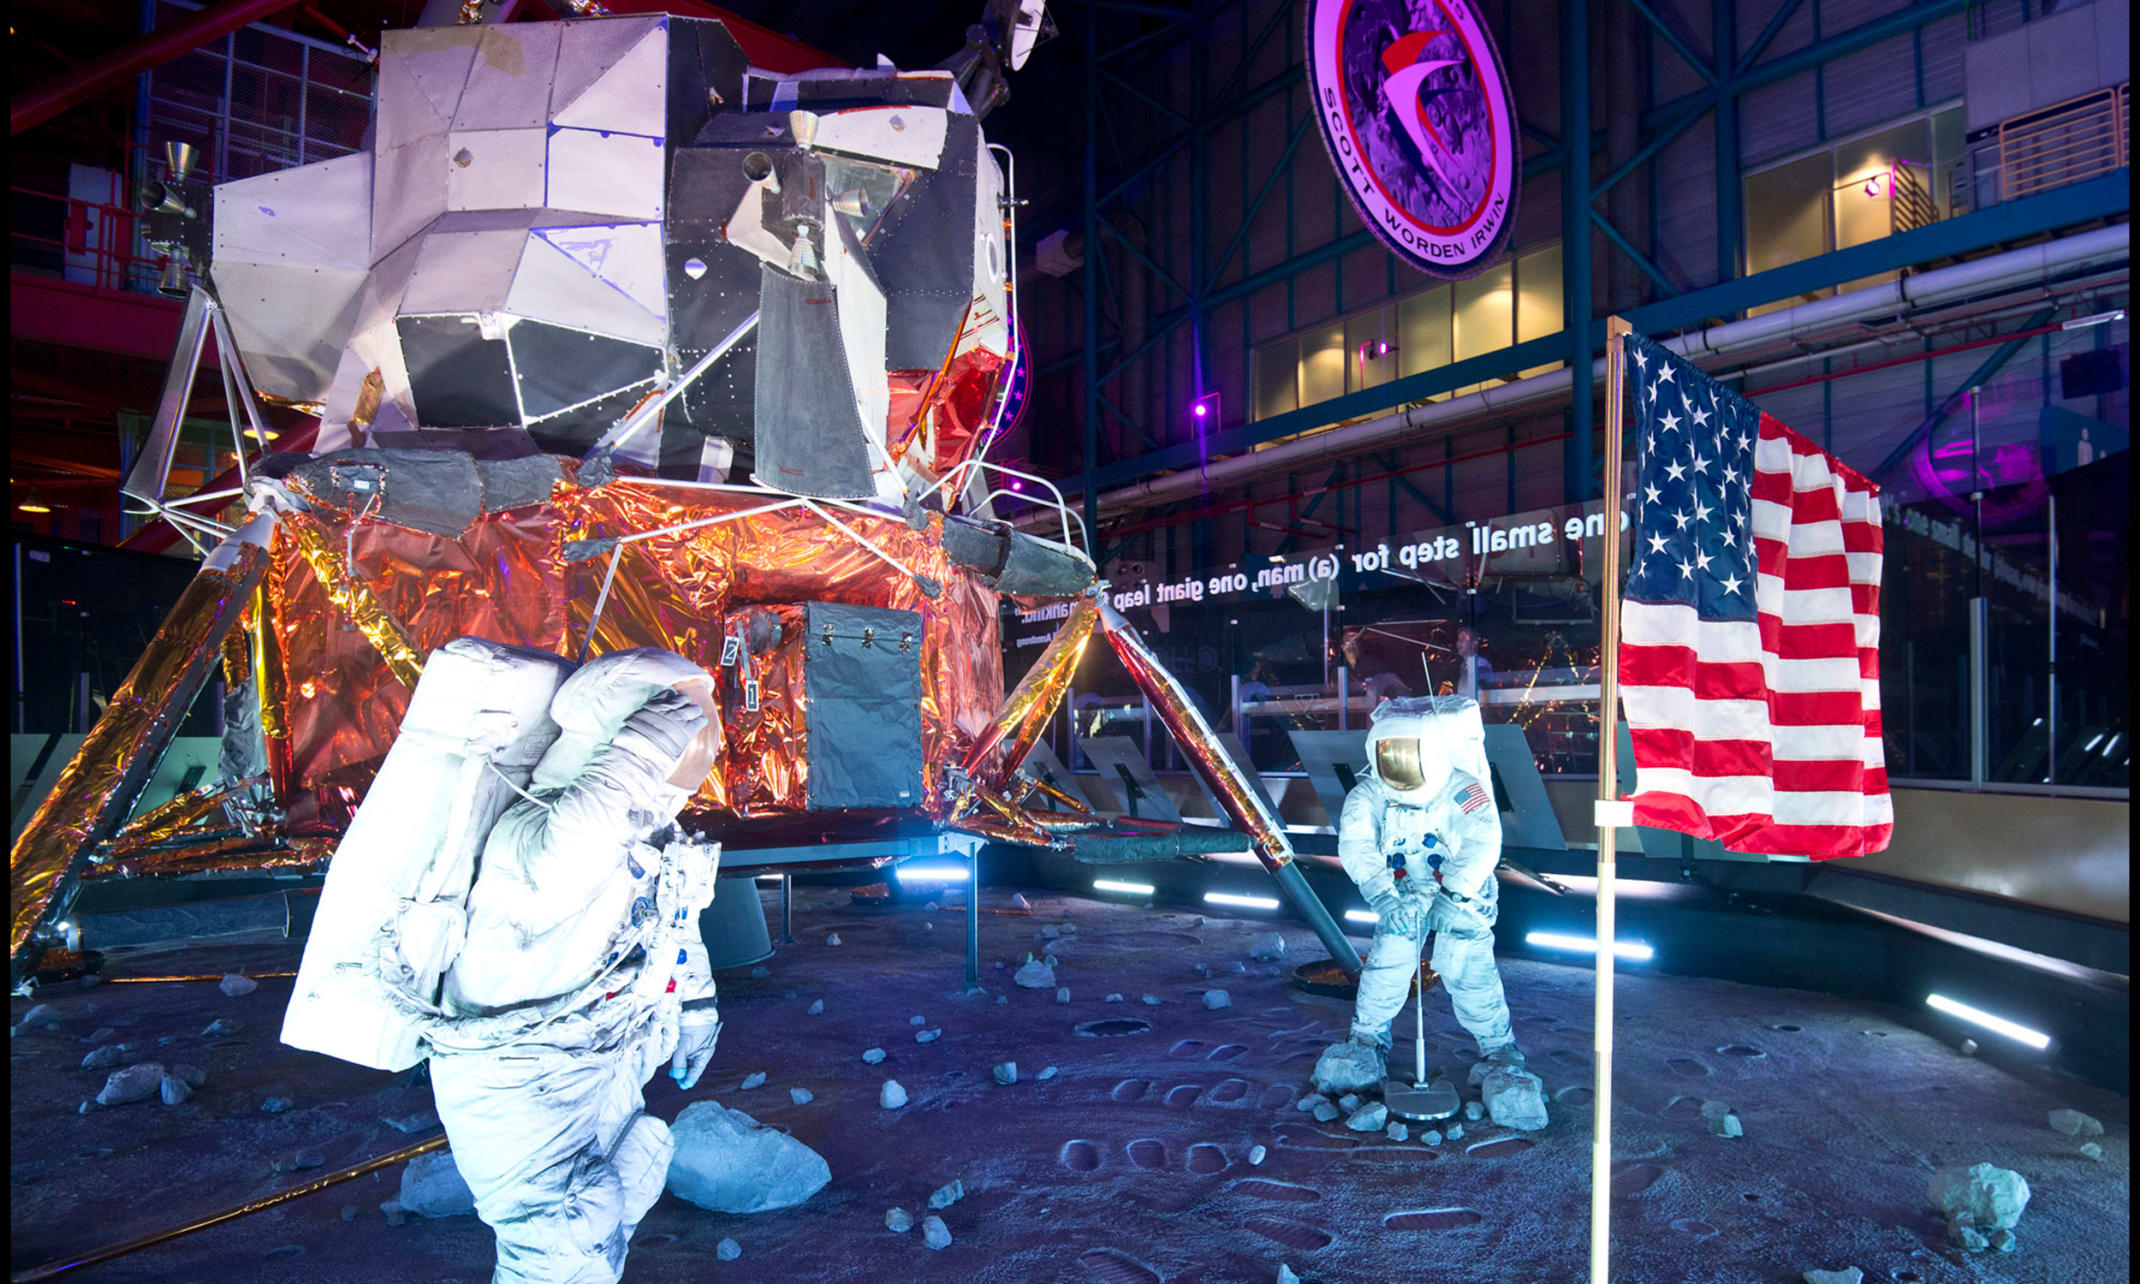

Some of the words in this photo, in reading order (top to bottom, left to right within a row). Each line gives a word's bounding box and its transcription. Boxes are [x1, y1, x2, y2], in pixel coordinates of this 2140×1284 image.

[1324, 87, 1375, 194] SCOTT
[1385, 208, 1465, 258] WORDEN
[1471, 192, 1505, 249] IRWIN
[725, 644, 738, 660] 2
